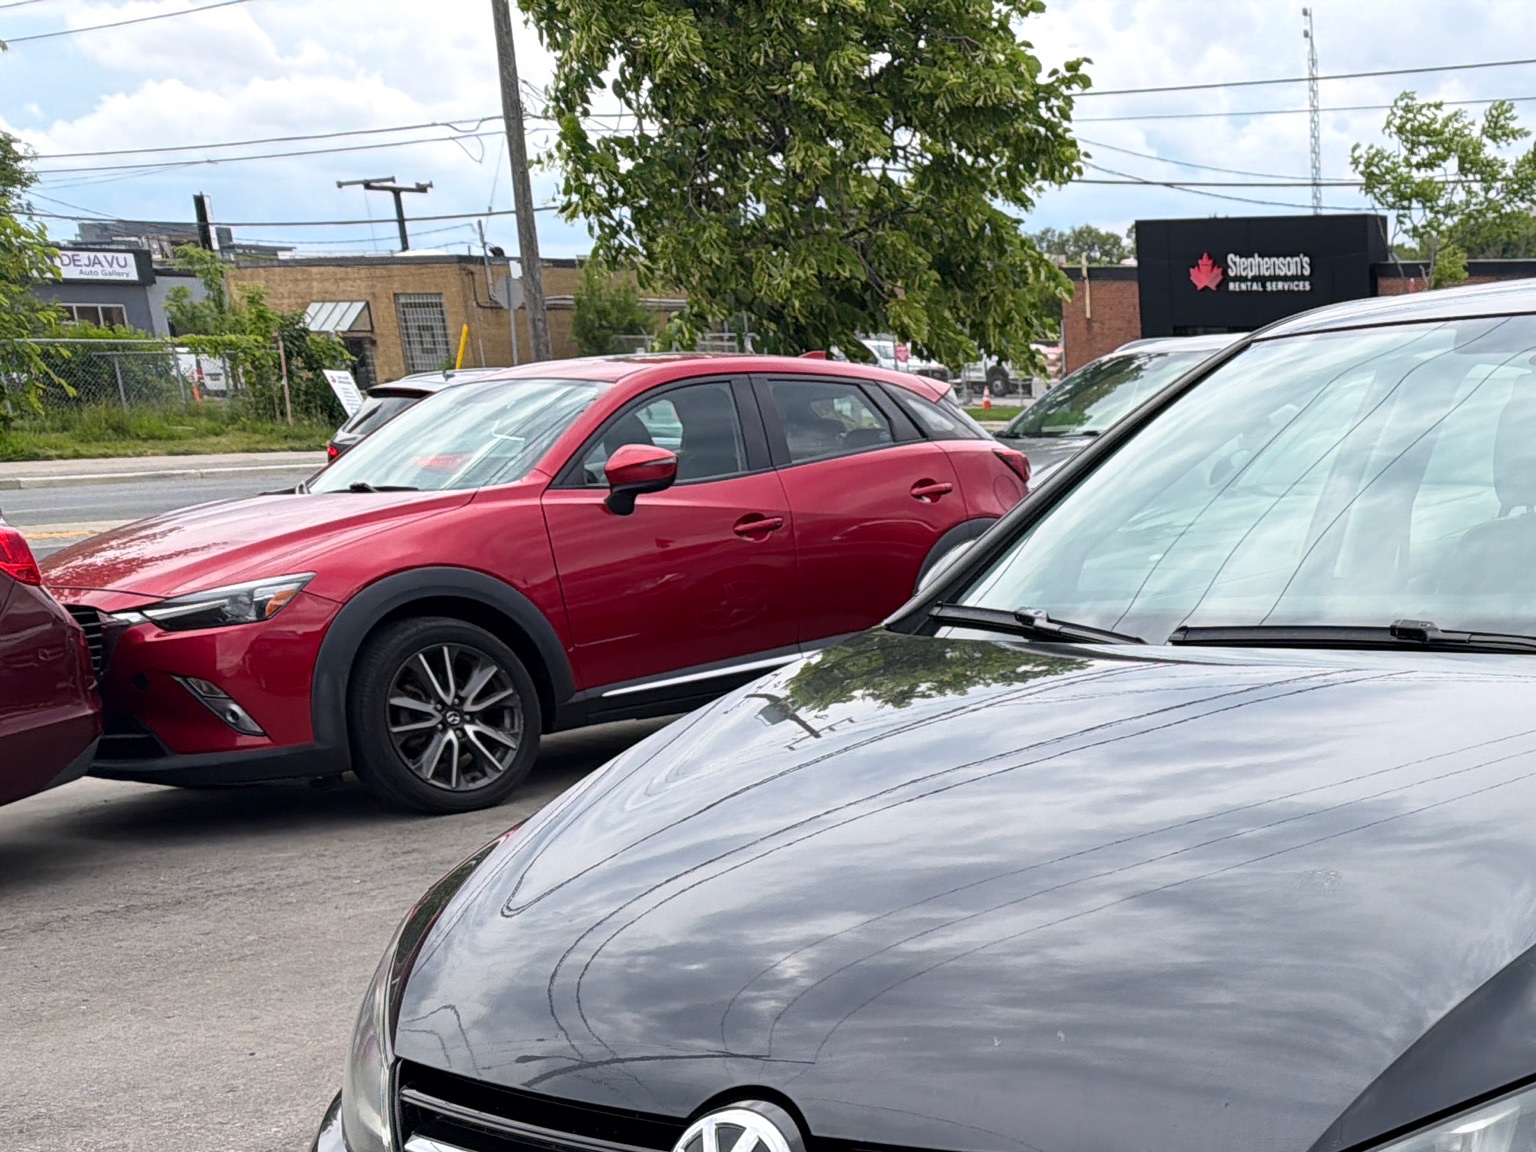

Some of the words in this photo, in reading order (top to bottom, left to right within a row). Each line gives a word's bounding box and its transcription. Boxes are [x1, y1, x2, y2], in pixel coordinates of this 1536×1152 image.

[1227, 252, 1311, 279] Stephenson's
[79, 269, 99, 277] Auto
[101, 269, 130, 278] Gallery
[1228, 281, 1263, 292] RENTAL
[1265, 281, 1311, 292] SERVICES
